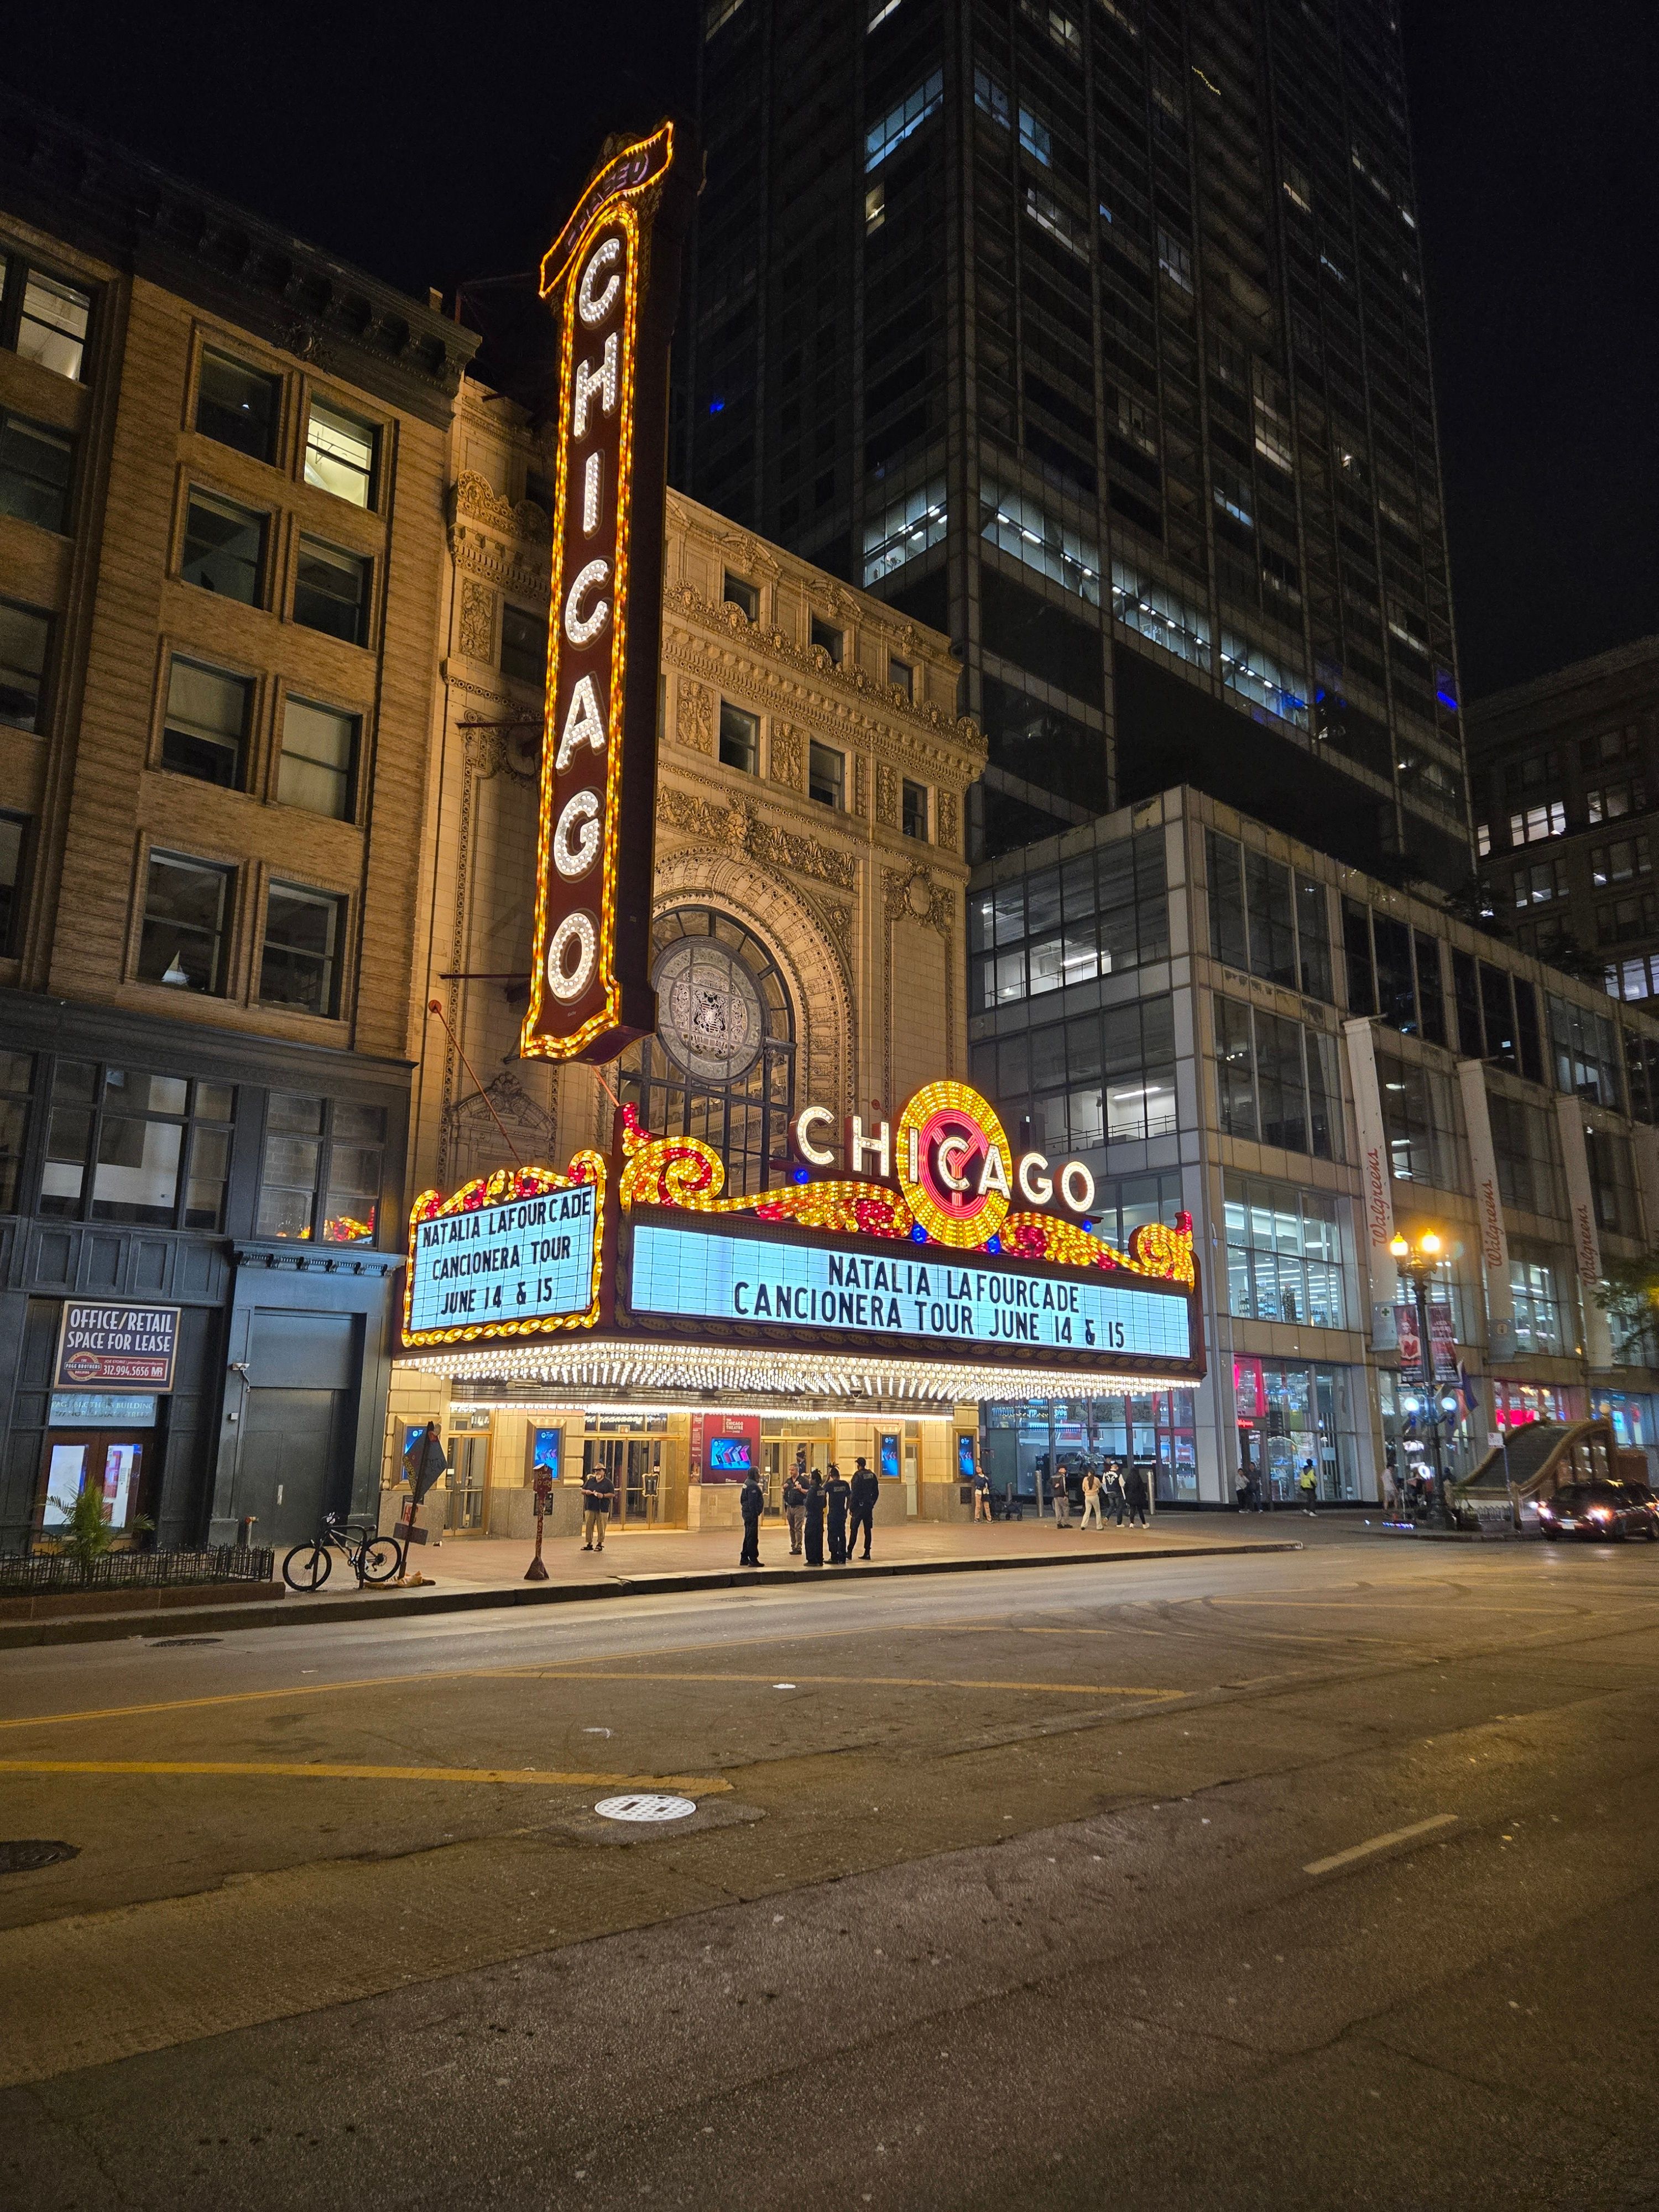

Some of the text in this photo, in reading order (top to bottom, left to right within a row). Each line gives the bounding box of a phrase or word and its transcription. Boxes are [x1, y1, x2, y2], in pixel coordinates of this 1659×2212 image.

[547, 237, 620, 999] CHICAGO
[797, 1106, 1095, 1212] CHICAGO
[422, 1191, 592, 1248] NATALIA LAFOURCADE
[1368, 1148, 1390, 1247] Walgreens
[1482, 1179, 1504, 1270] Walgreens
[432, 1235, 571, 1281] CANCIONERA TOUR
[1578, 1204, 1598, 1286] Walgreens
[441, 1277, 552, 1314] JUNE 14 & 15
[829, 1254, 1079, 1313] NATALIA LAFOURCADE
[67, 1331, 171, 1352] SPACE FOR LEASE
[70, 1308, 173, 1333] OFFICE/RETAIL
[734, 1281, 1124, 1348] CANCIONERA TOUR JUNE 14 & 15
[102, 1365, 149, 1376] 312.994.5656
